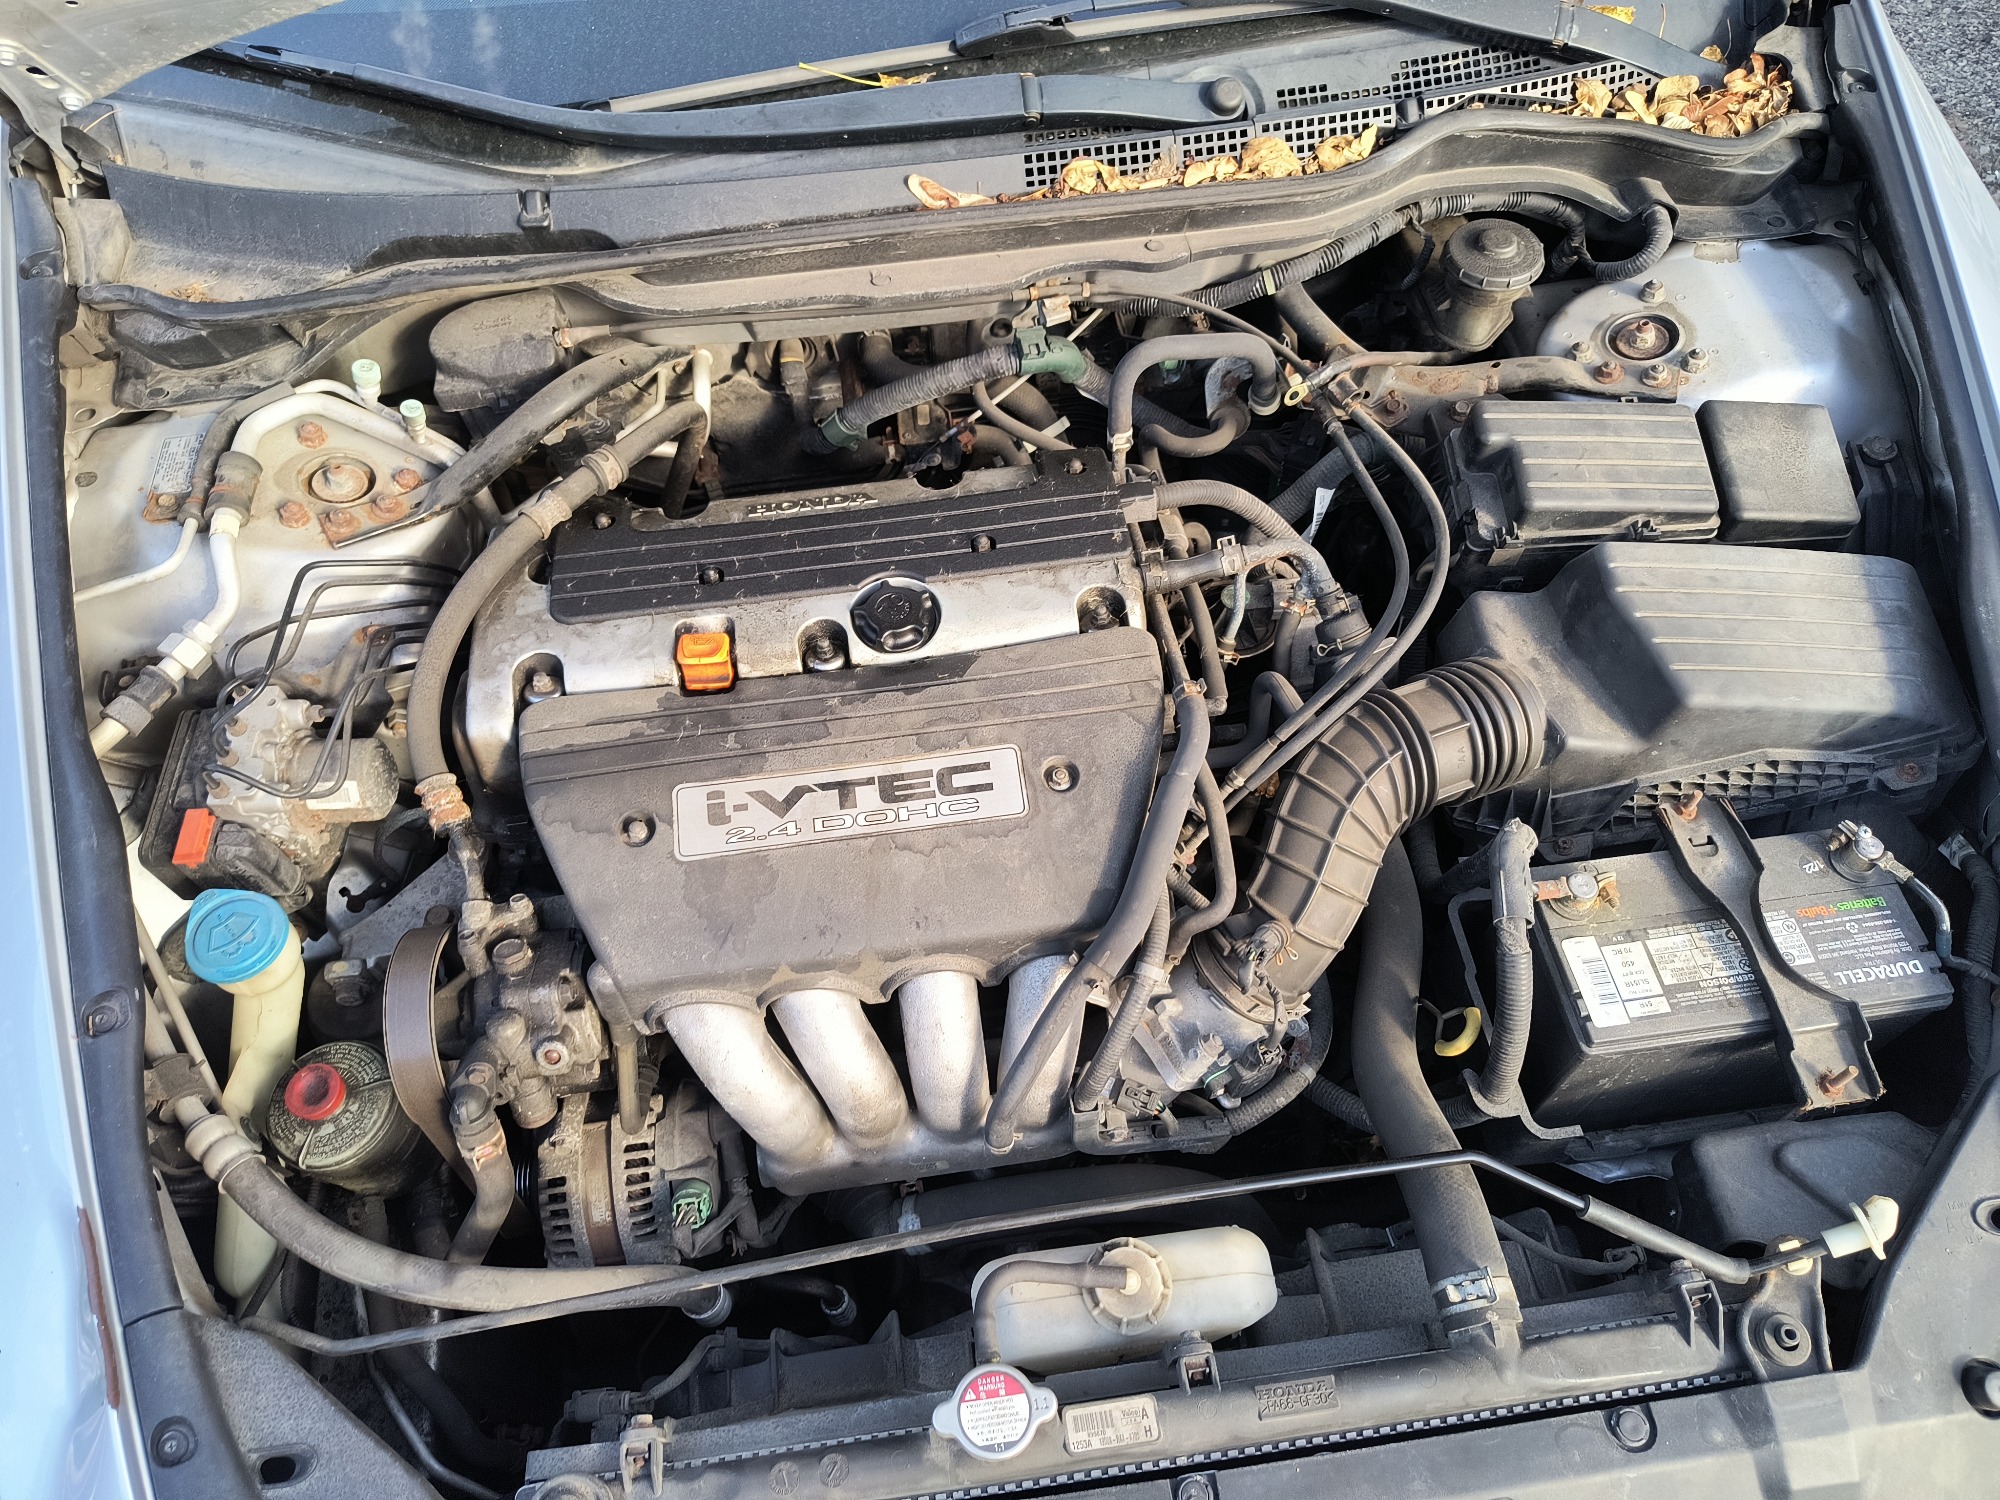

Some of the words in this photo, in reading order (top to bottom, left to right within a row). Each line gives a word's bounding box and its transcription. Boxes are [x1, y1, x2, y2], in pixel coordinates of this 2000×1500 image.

[746, 492, 878, 518] HONDA
[706, 761, 994, 826] i-VTEC
[725, 820, 801, 845] 2.4
[812, 798, 980, 833] DOHC
[1836, 896, 1886, 912] Batteries
[1796, 905, 1828, 919] Bulbs
[1833, 959, 1924, 985] DURACELL
[977, 1375, 1004, 1384] DANGER
[1256, 1380, 1328, 1400] HONDA
[1034, 1396, 1049, 1411] 1.1
[1141, 1407, 1149, 1420] A
[1144, 1425, 1153, 1438] H
[994, 1442, 1006, 1452] 1.1
[1072, 1439, 1093, 1450] 1253A
